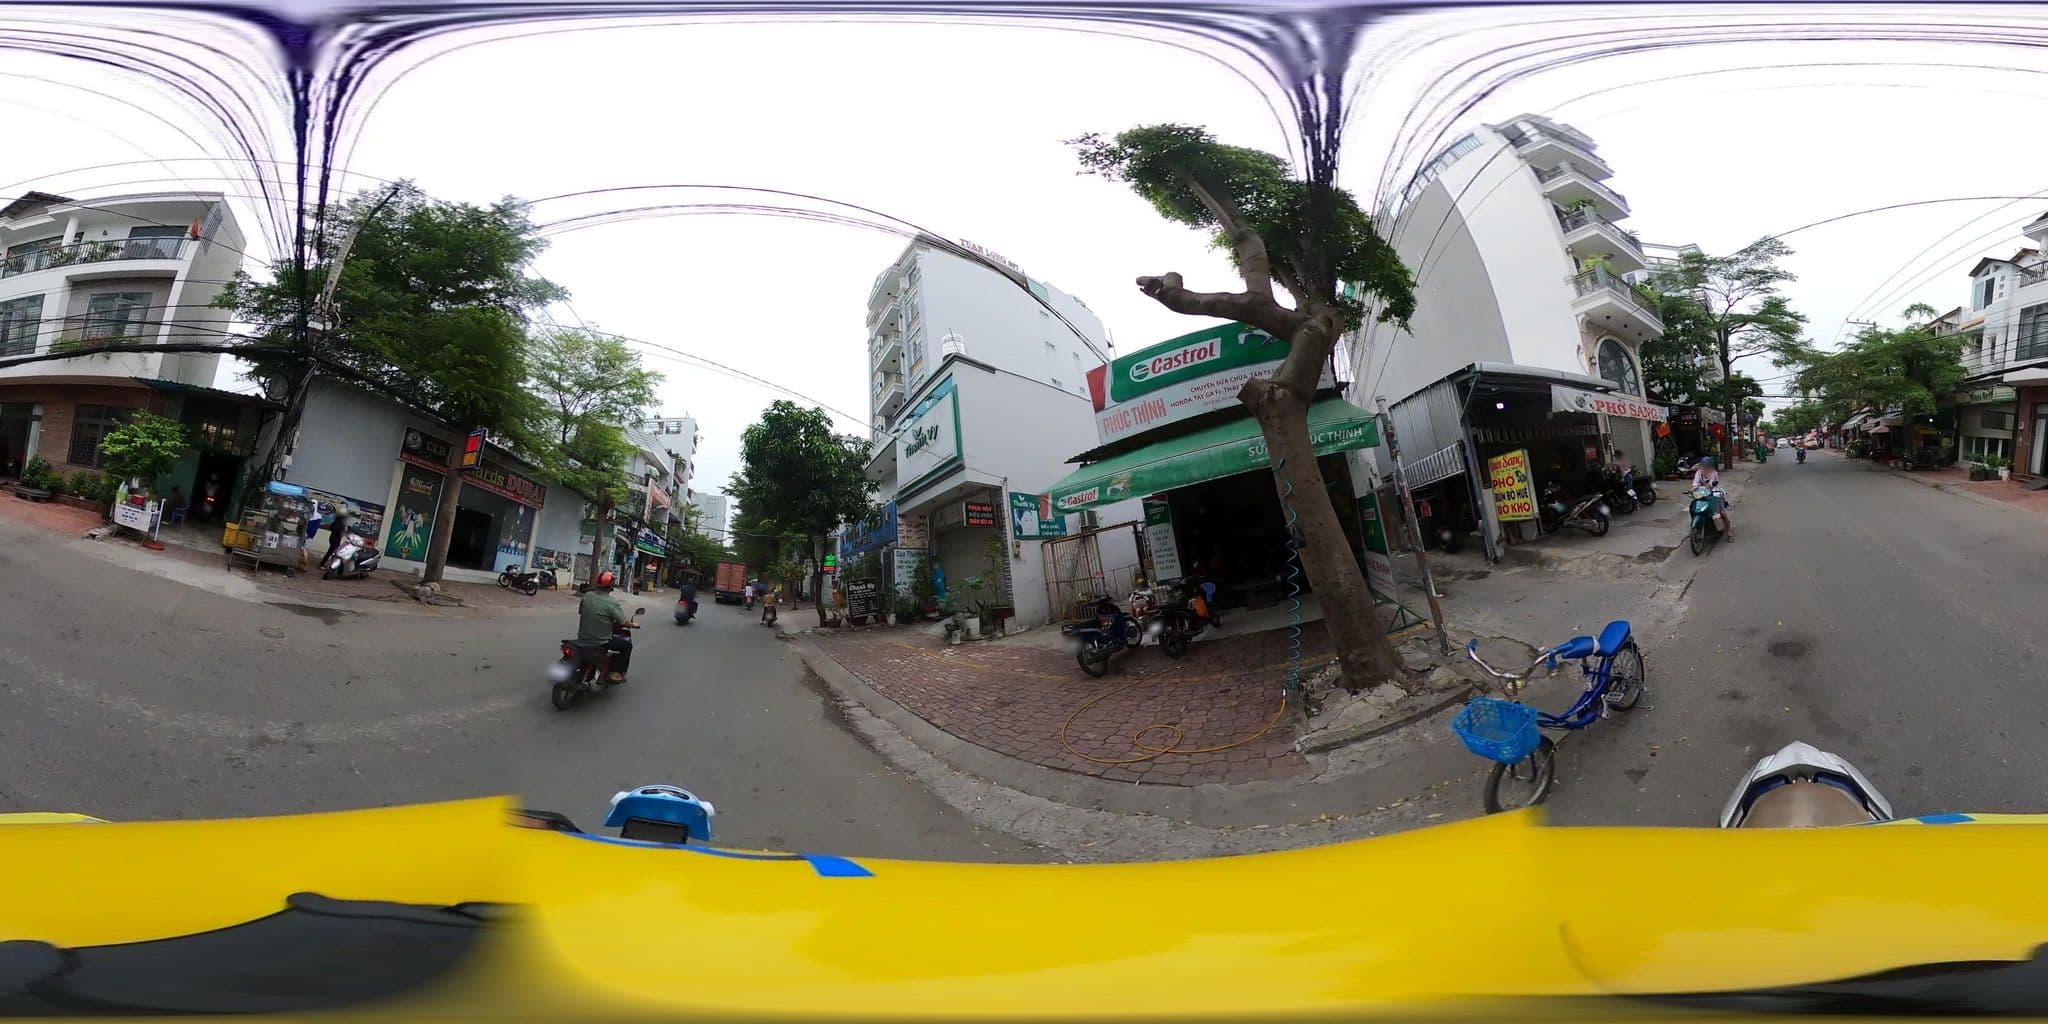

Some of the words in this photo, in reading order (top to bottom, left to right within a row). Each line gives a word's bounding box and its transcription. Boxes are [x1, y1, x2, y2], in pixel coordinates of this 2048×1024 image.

[1151, 342, 1216, 375] Castrol
[1132, 398, 1167, 425] THỊNH
[1629, 404, 1657, 419] SANG
[1327, 427, 1362, 443] THỊNH
[1067, 490, 1096, 506] Castrol
[1511, 502, 1531, 513] KHO
